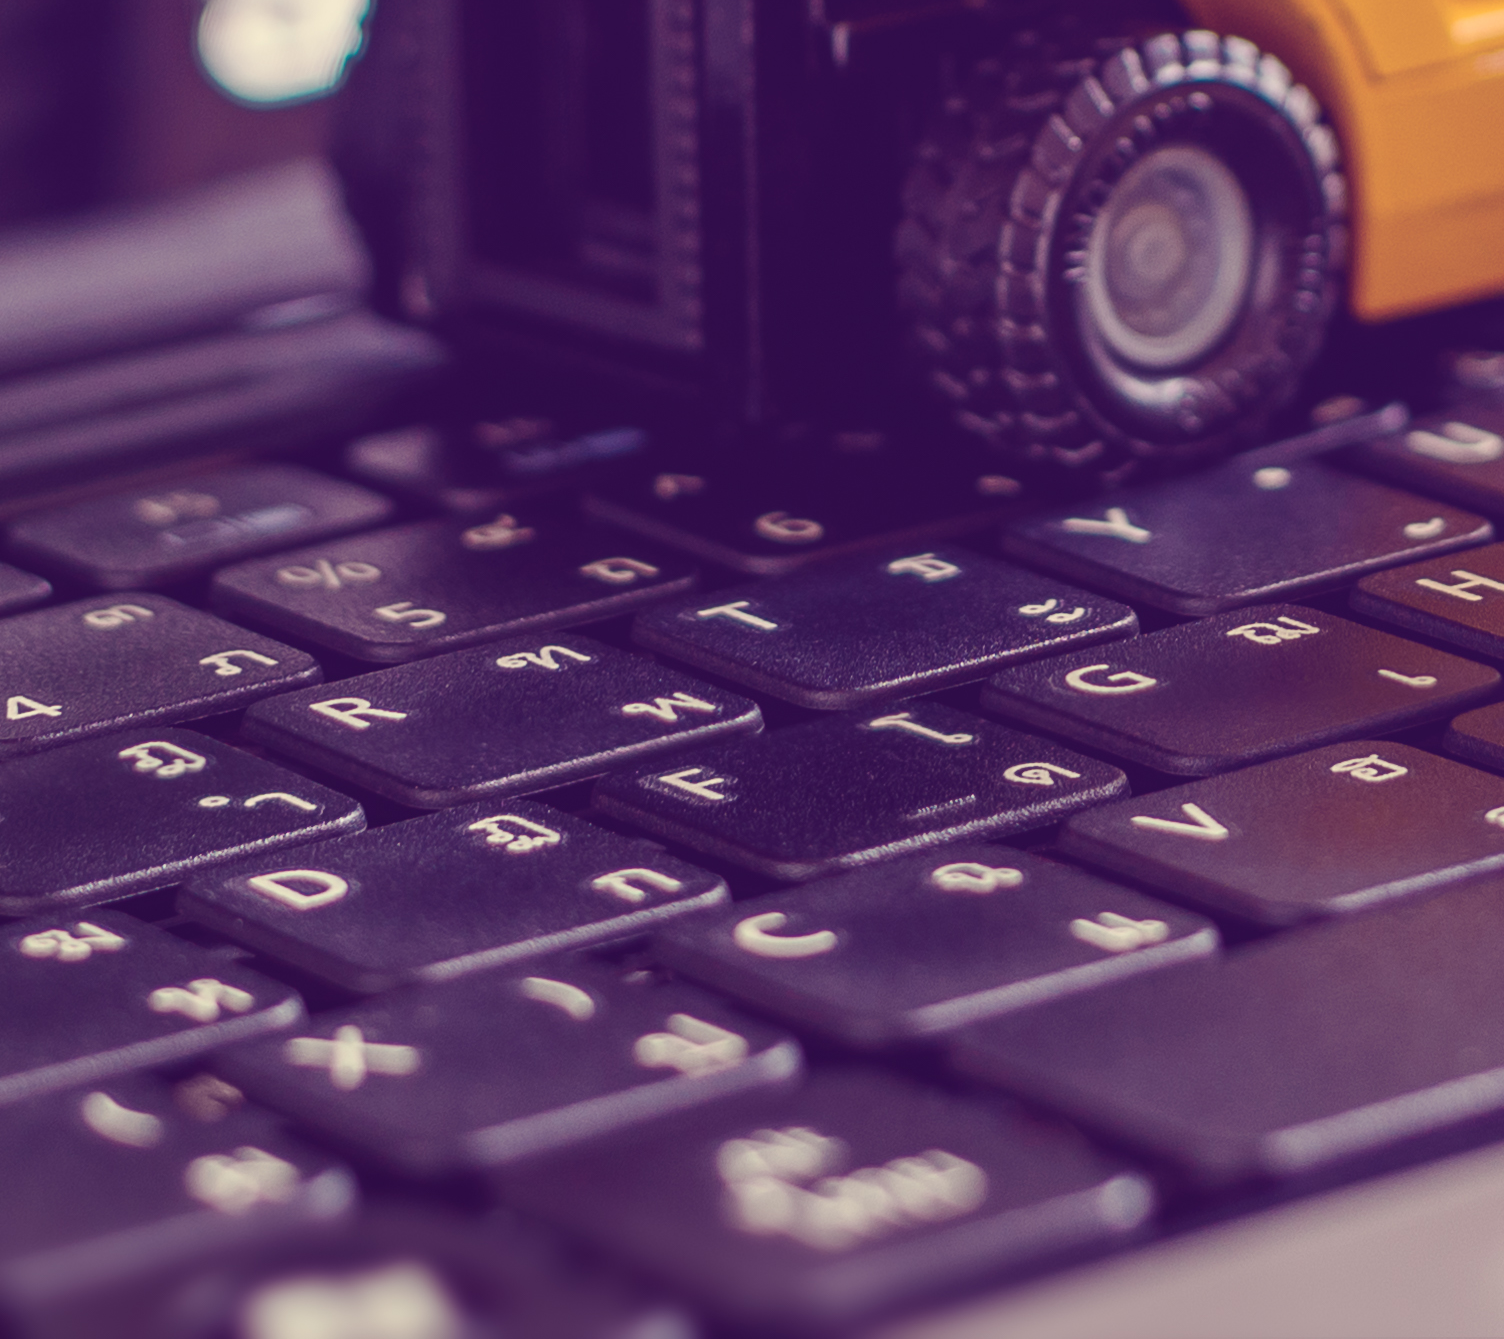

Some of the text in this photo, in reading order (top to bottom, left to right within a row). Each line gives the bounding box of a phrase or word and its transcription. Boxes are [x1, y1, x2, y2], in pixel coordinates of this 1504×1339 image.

[754, 513, 824, 541] 6
[1062, 507, 1152, 544] Y
[278, 559, 381, 589] %
[374, 601, 446, 628] 5
[696, 599, 779, 631] T
[1064, 663, 1158, 695] G
[6, 695, 62, 721] 4
[308, 696, 408, 730] R
[658, 767, 726, 801] F
[1130, 801, 1230, 841] V
[247, 869, 350, 911] D
[590, 866, 684, 905] ก
[732, 911, 838, 958] C
